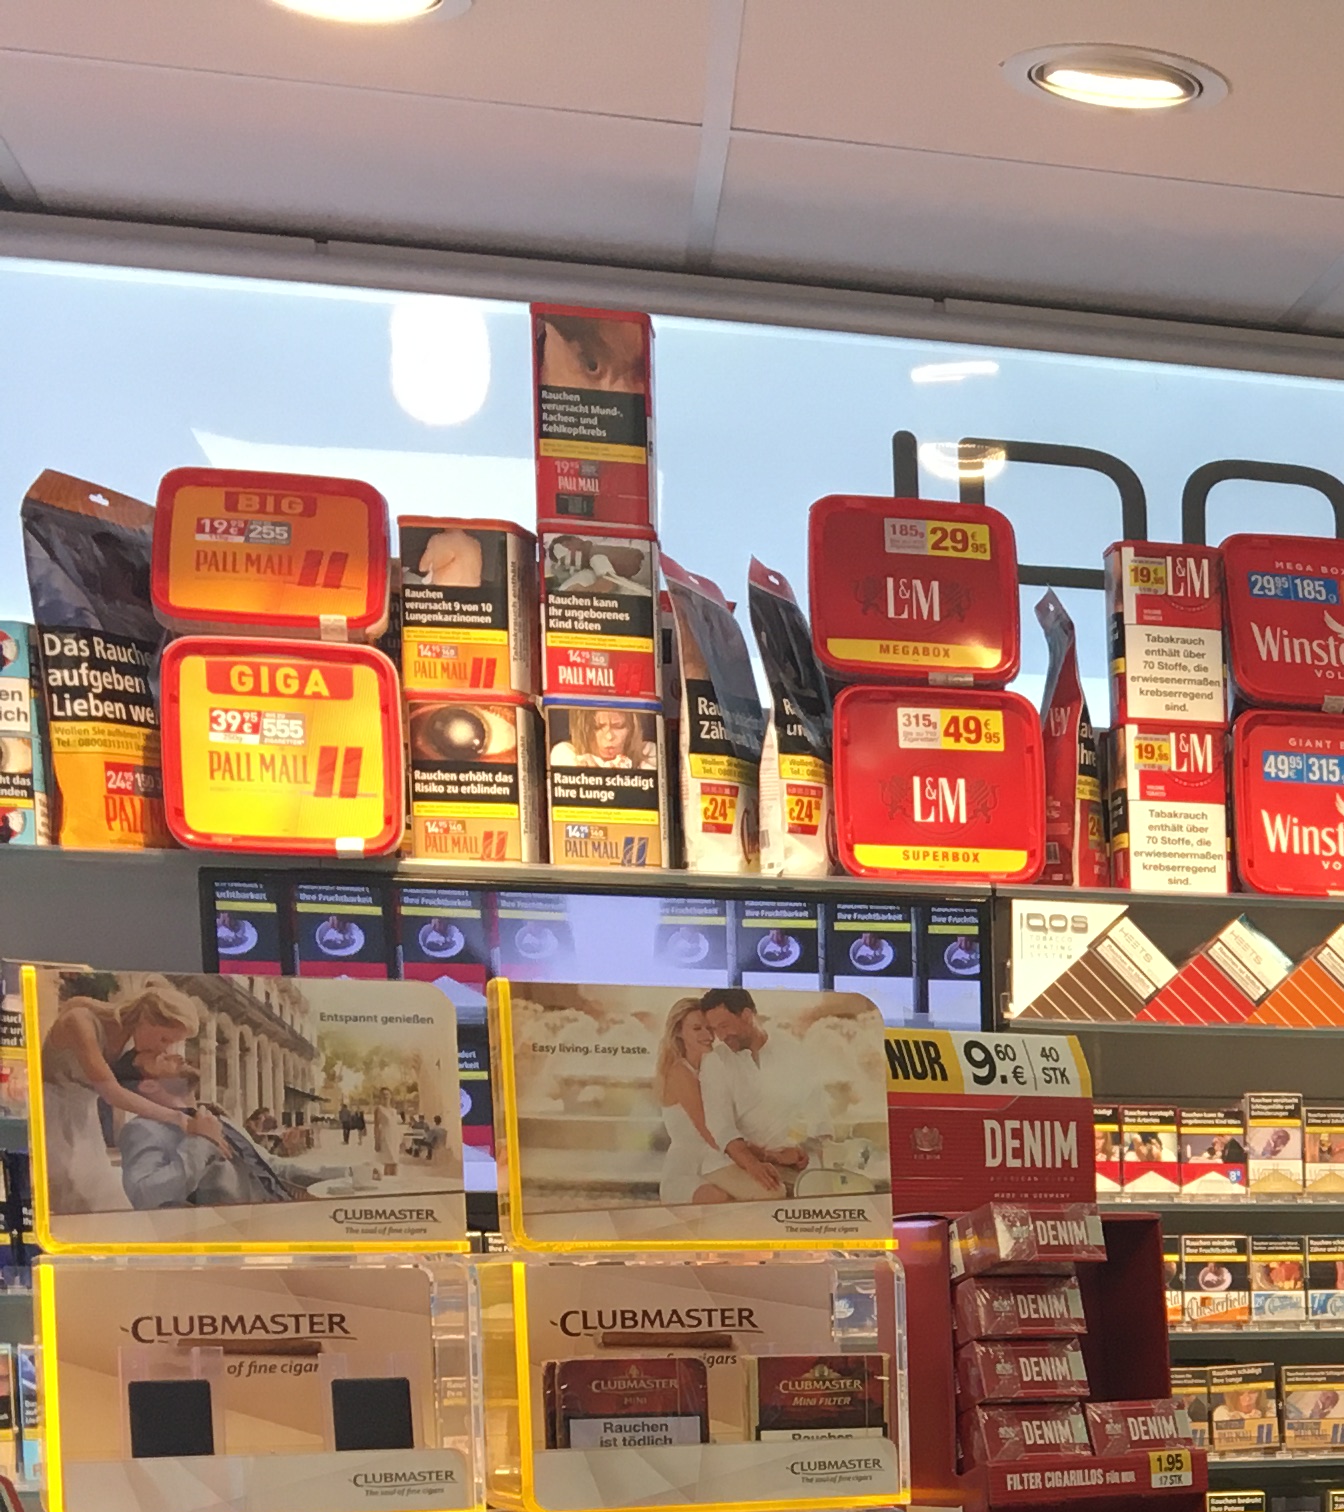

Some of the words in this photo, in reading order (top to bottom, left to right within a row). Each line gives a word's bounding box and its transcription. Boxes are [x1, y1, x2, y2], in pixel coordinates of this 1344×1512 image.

[1275, 561, 1314, 572] MEGA
[548, 594, 592, 607] Rauchen
[595, 597, 619, 609] kann
[548, 607, 563, 618] Ihr
[565, 609, 630, 623] ungeborenes
[548, 618, 572, 630] Kind
[574, 618, 601, 632] töten
[1145, 633, 1205, 647] Tabakrauch
[879, 644, 951, 659] MEGABOX
[1145, 647, 1179, 658] enthält
[1181, 647, 1206, 660] über
[1143, 661, 1155, 670] 70
[1157, 661, 1191, 673] Stoffe,
[1194, 662, 1209, 673] die
[230, 665, 330, 697] GIGA
[1139, 688, 1214, 702] krebserregend
[1165, 701, 1189, 712] sind.
[1288, 737, 1332, 750] GIANT
[208, 751, 255, 783] PALL
[259, 753, 310, 785] MALL
[554, 772, 602, 787] Rauchen
[605, 775, 654, 791] schädigt
[554, 785, 576, 799] Ihre
[579, 787, 615, 802] Lunge
[912, 776, 967, 824] L&M
[902, 849, 981, 864] SUPERBOX
[1020, 912, 1088, 934] IQOS
[319, 1010, 376, 1026] Entspannt
[379, 1012, 435, 1028] genießen
[532, 1042, 556, 1056] Easy
[558, 1043, 592, 1056] living.
[594, 1043, 618, 1056] Easy
[620, 1044, 650, 1055] taste.
[1040, 1046, 1060, 1063] 40
[889, 1048, 949, 1082] NUR
[1041, 1066, 1070, 1085] STK
[983, 1118, 1079, 1170] DENIM
[331, 1207, 437, 1224] CLUBMASTER
[130, 1313, 351, 1344] CLUBMASTER
[1006, 1470, 1041, 1491] FILTER
[1044, 1469, 1104, 1488] CIGARILLOS
